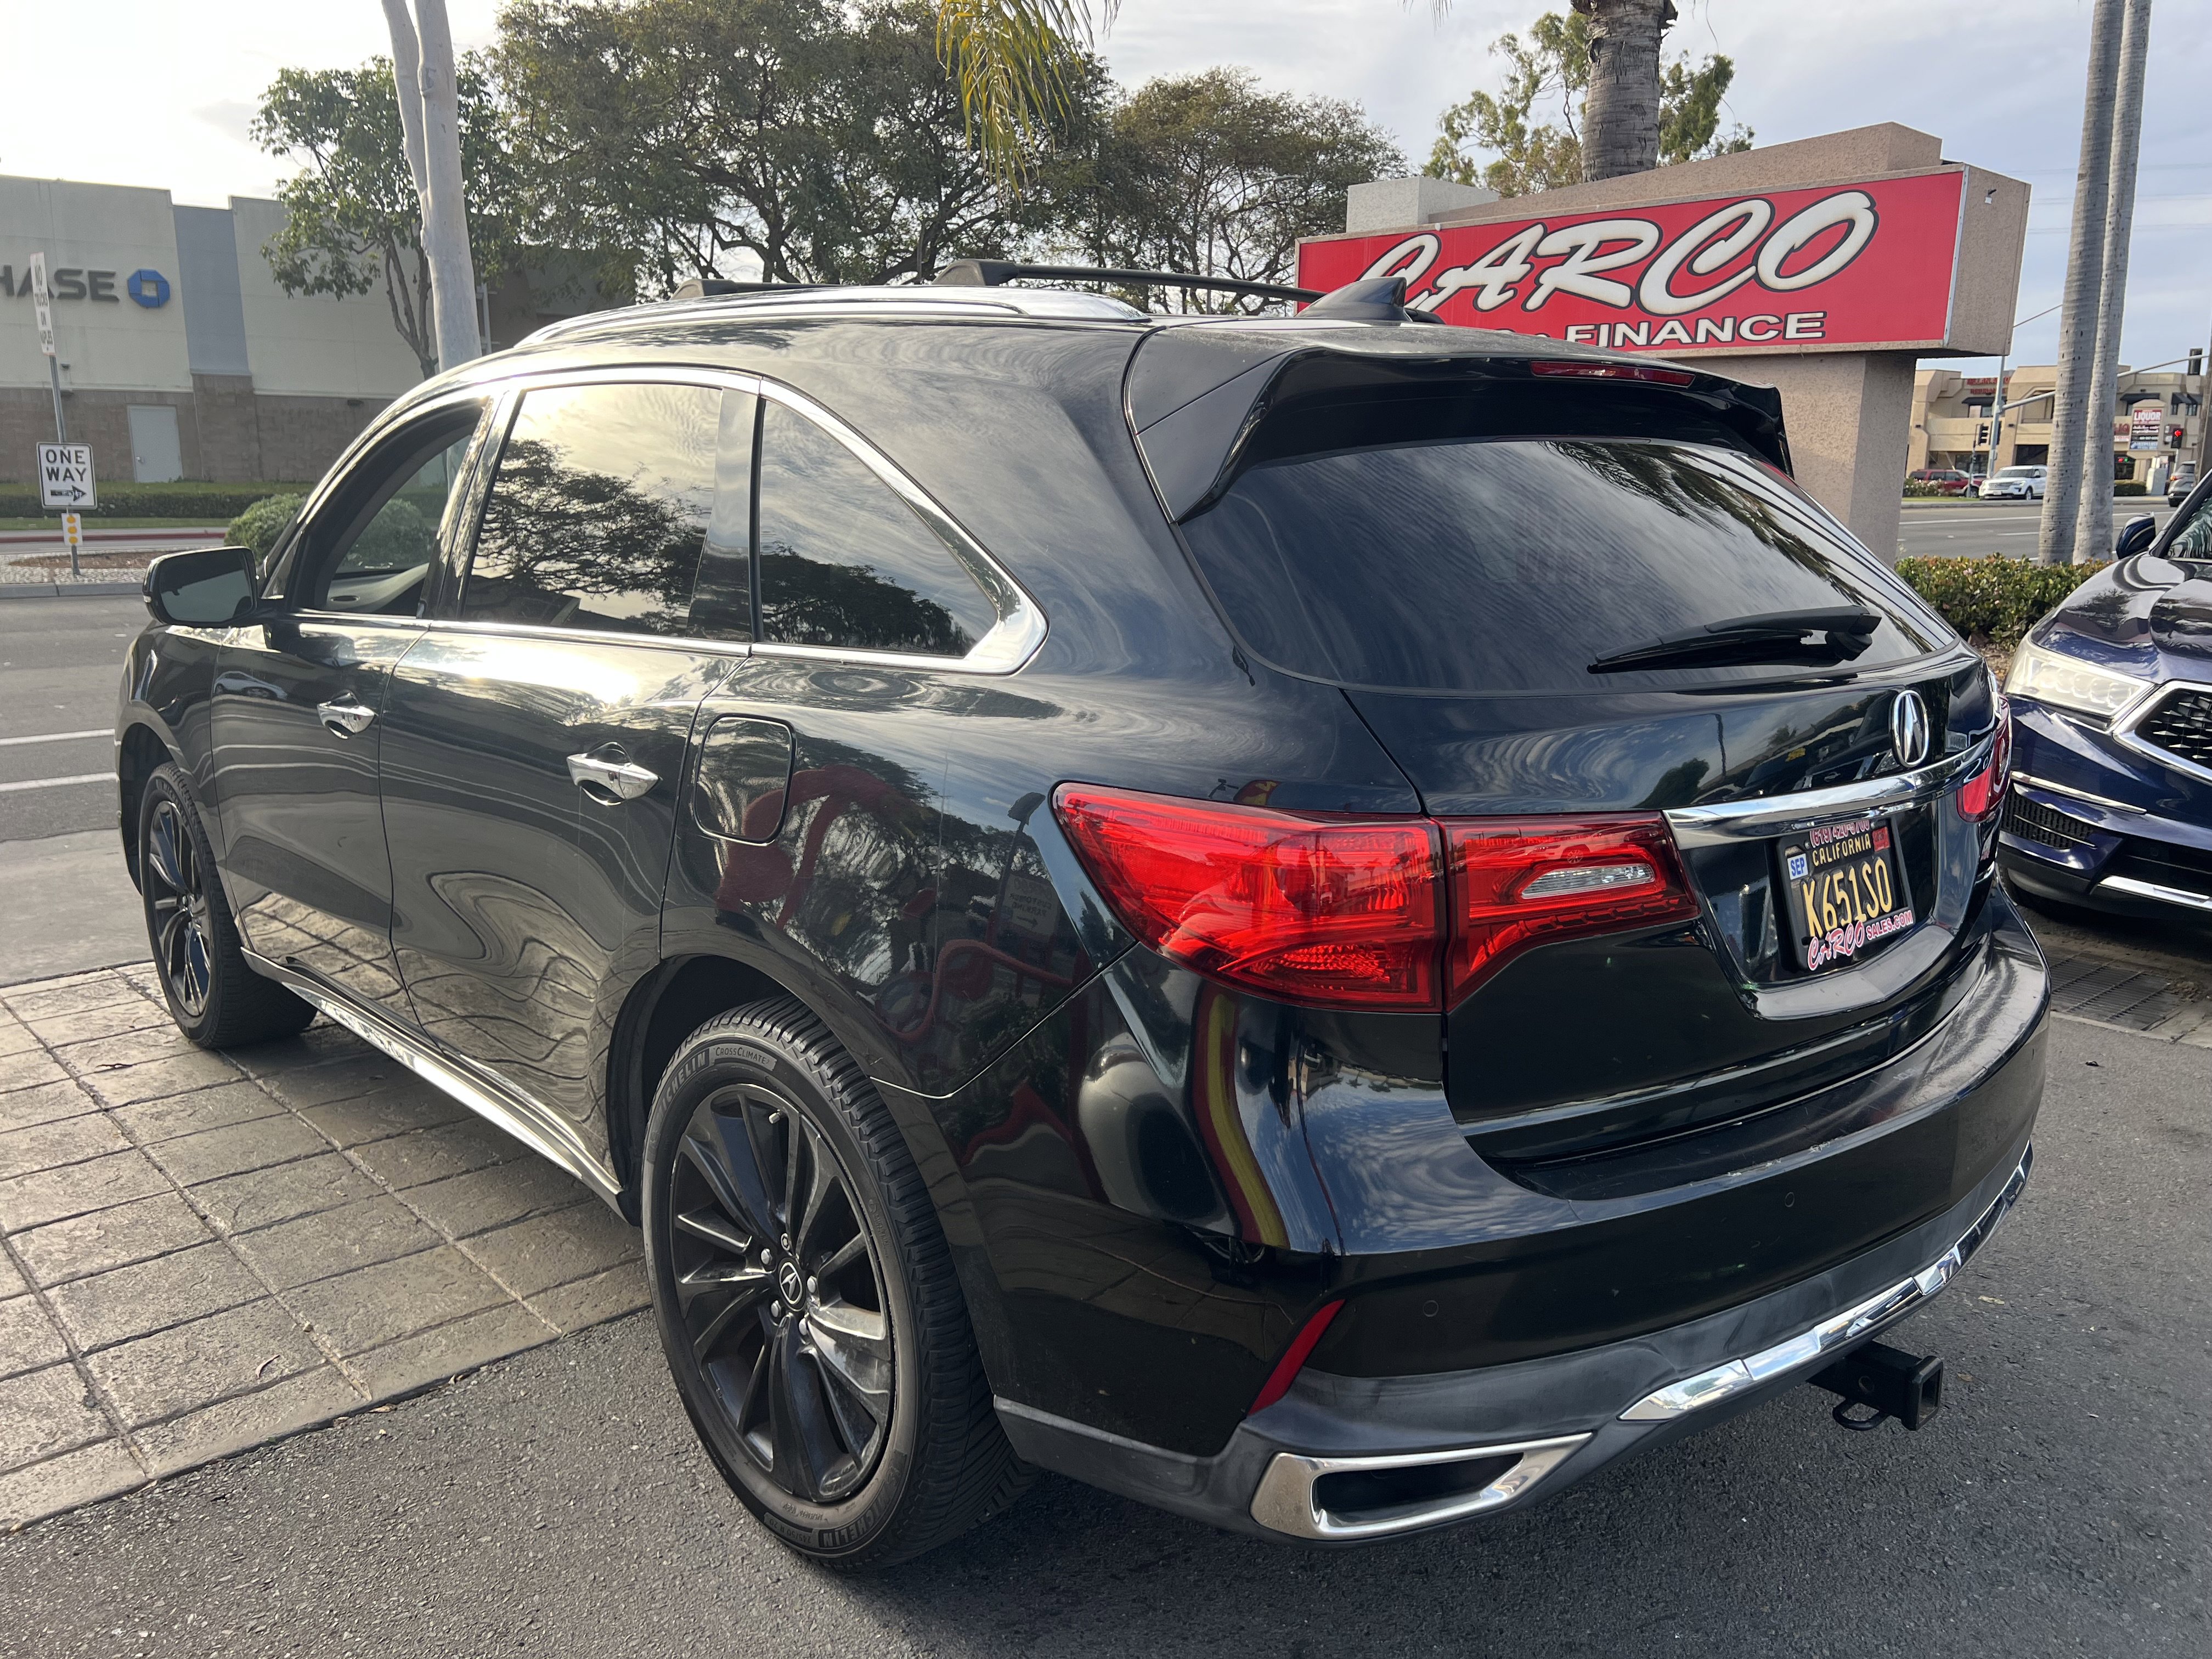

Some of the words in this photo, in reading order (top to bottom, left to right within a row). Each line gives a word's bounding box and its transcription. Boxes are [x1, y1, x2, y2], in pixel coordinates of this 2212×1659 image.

[1354, 189, 1878, 317] CARCO
[35, 264, 43, 286] NO
[1565, 311, 1826, 347] FINANCE
[2134, 411, 2162, 421] LIQUOR
[46, 448, 86, 465] ONE
[46, 466, 87, 482] WAY
[1812, 833, 1871, 867] CALIFORNIA
[1790, 856, 1805, 877] SEP
[1865, 910, 1914, 941] SALES.COM
